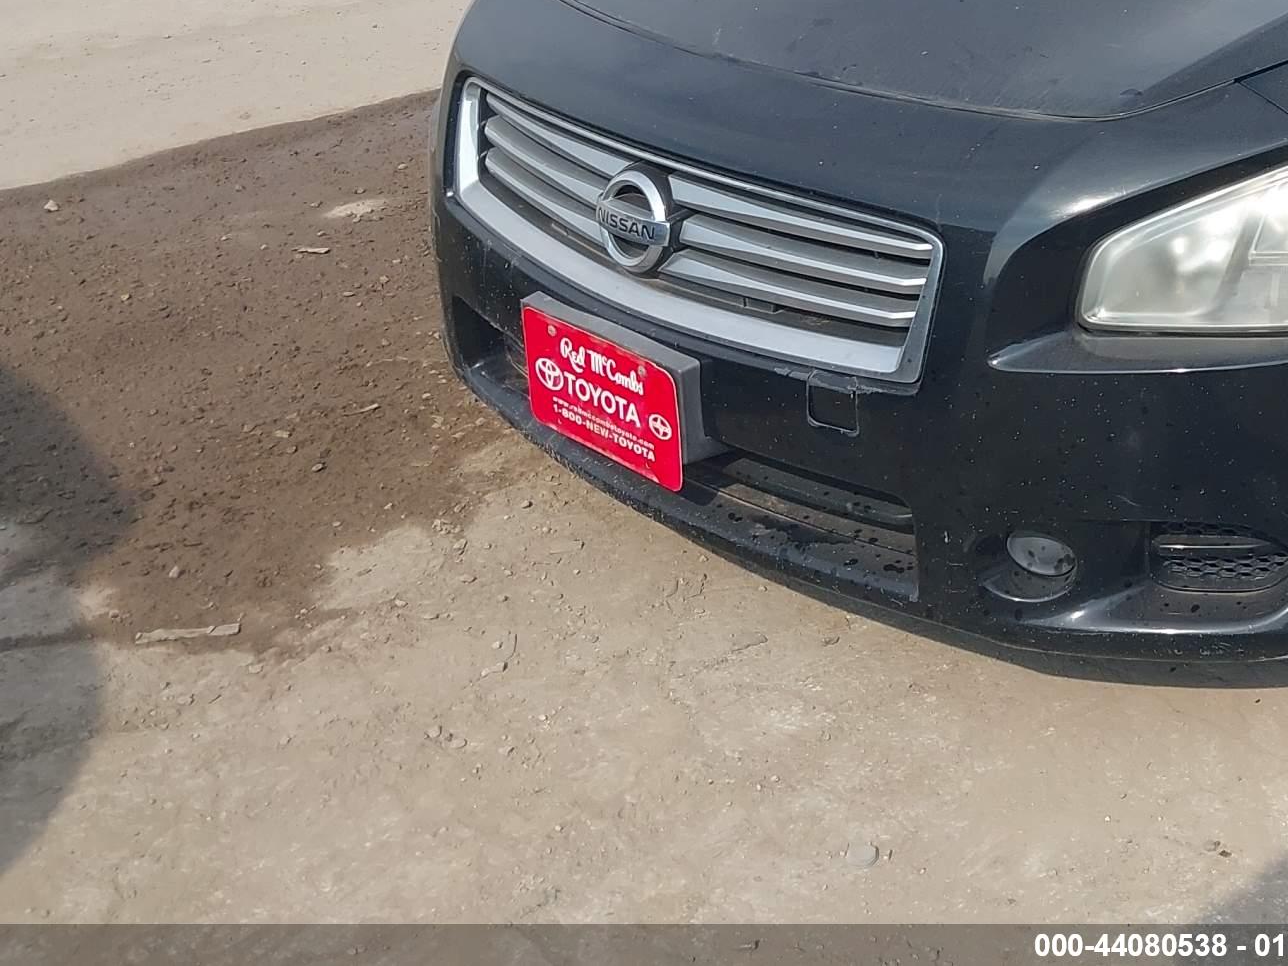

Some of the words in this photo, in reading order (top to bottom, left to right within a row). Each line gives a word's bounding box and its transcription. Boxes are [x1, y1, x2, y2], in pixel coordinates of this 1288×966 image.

[599, 207, 655, 240] NISSAN
[560, 337, 586, 373] Red
[587, 349, 644, 396] McCombs
[563, 371, 641, 428] TOYOTA
[553, 403, 656, 462] 1-800-NEW-TOYOTA
